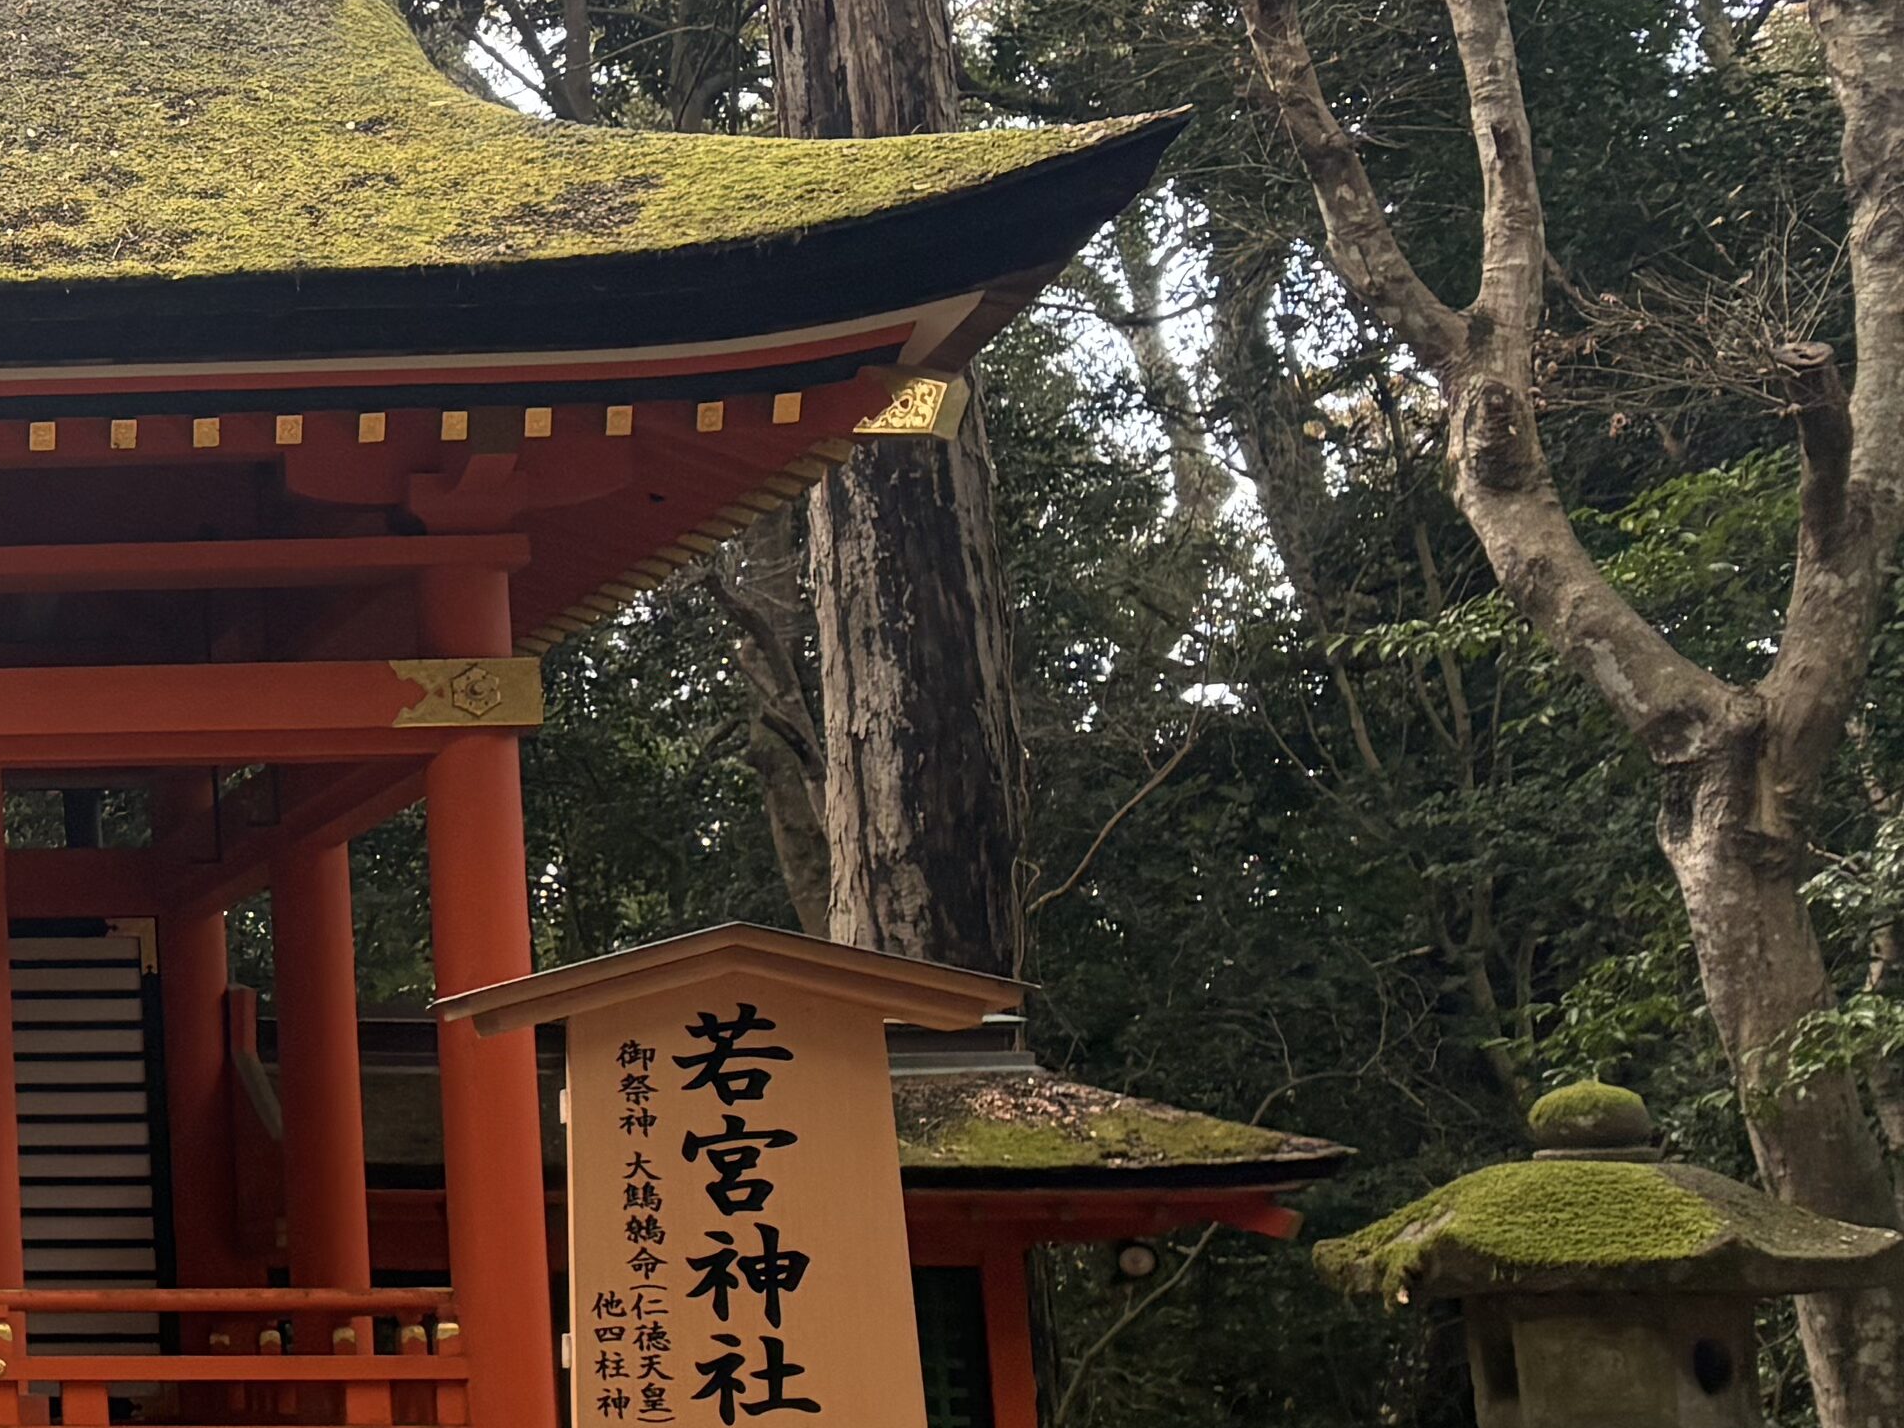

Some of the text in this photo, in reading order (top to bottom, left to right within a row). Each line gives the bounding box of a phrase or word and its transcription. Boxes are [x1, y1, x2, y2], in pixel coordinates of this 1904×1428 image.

[616, 1039, 659, 1138] 御祭神
[672, 1003, 822, 1427] 若宮神社
[591, 1290, 631, 1420] 他四柱神
